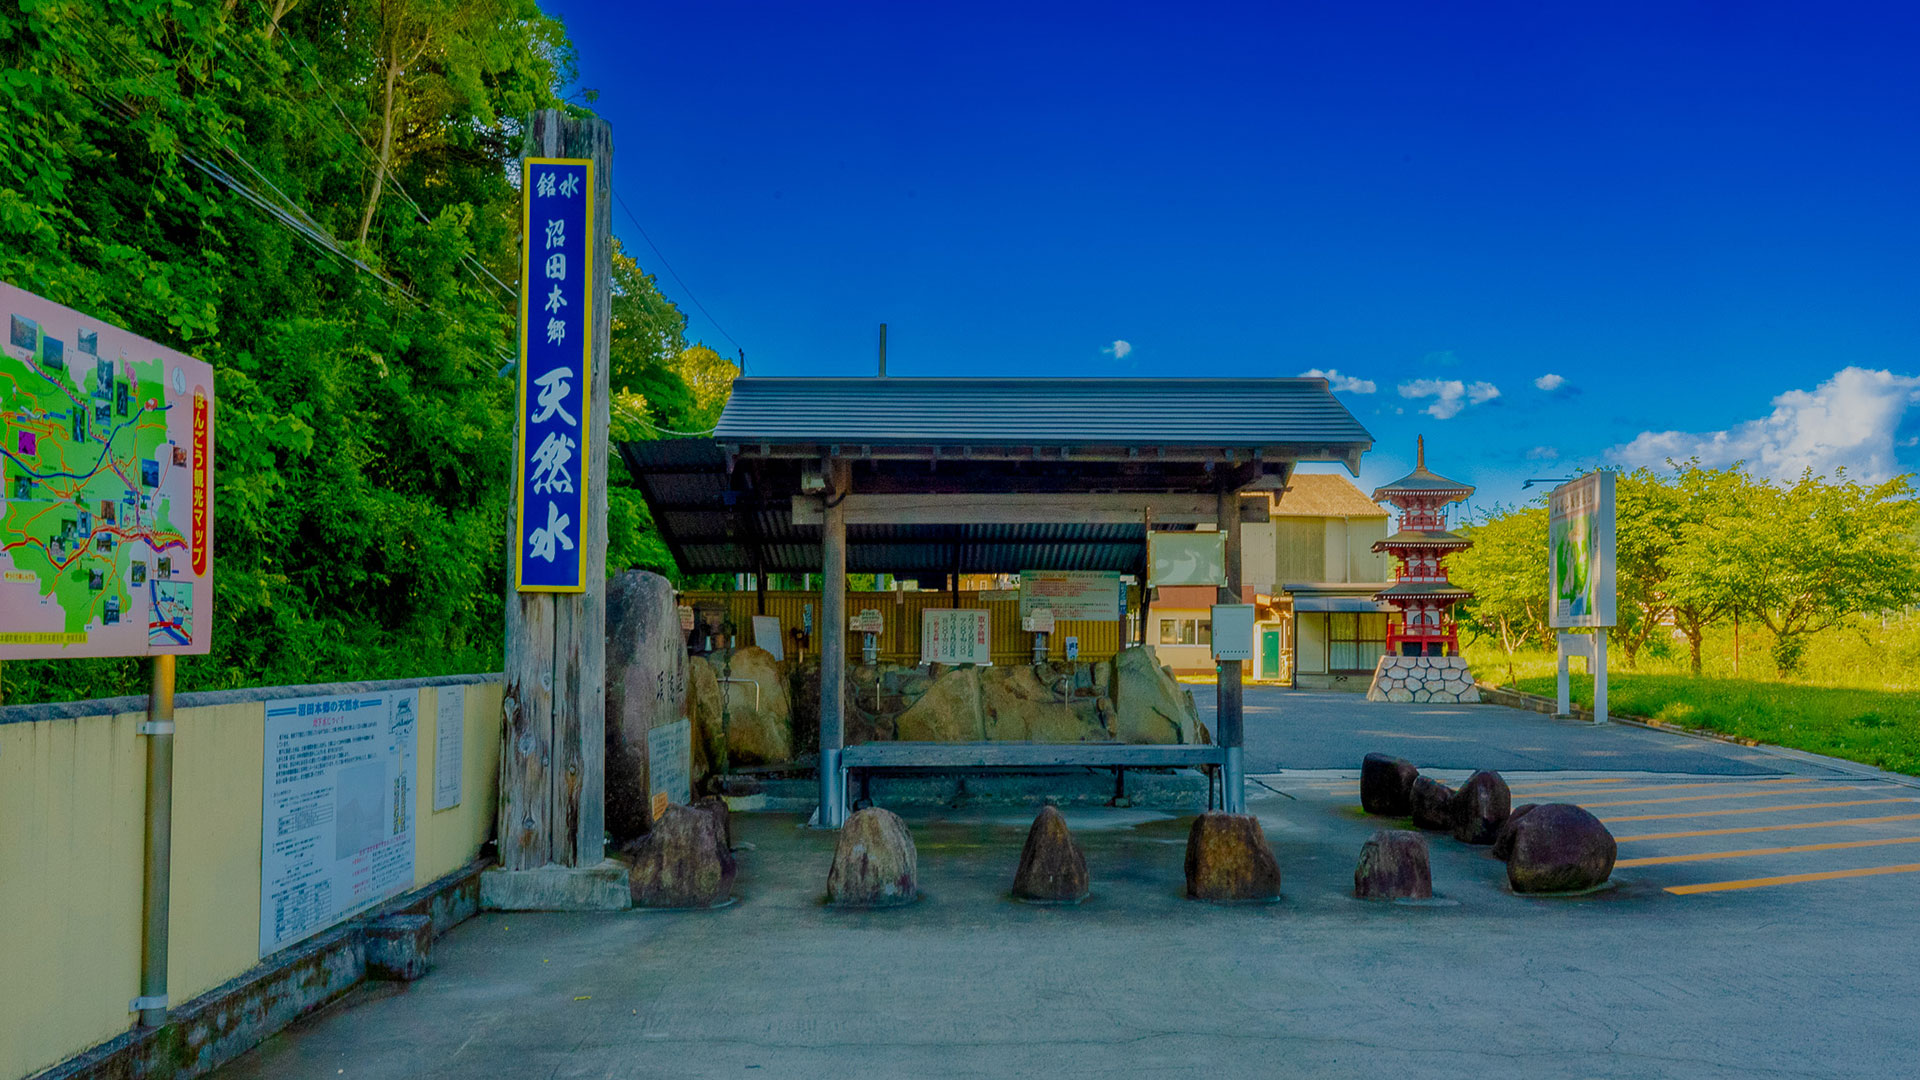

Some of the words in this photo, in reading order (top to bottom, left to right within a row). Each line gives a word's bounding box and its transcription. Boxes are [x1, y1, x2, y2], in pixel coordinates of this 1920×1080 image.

[536, 172, 580, 199] 銘水
[545, 219, 568, 347] 沼田本郷
[193, 391, 205, 566] ほんごう観光マップ
[528, 366, 577, 563] 天然水
